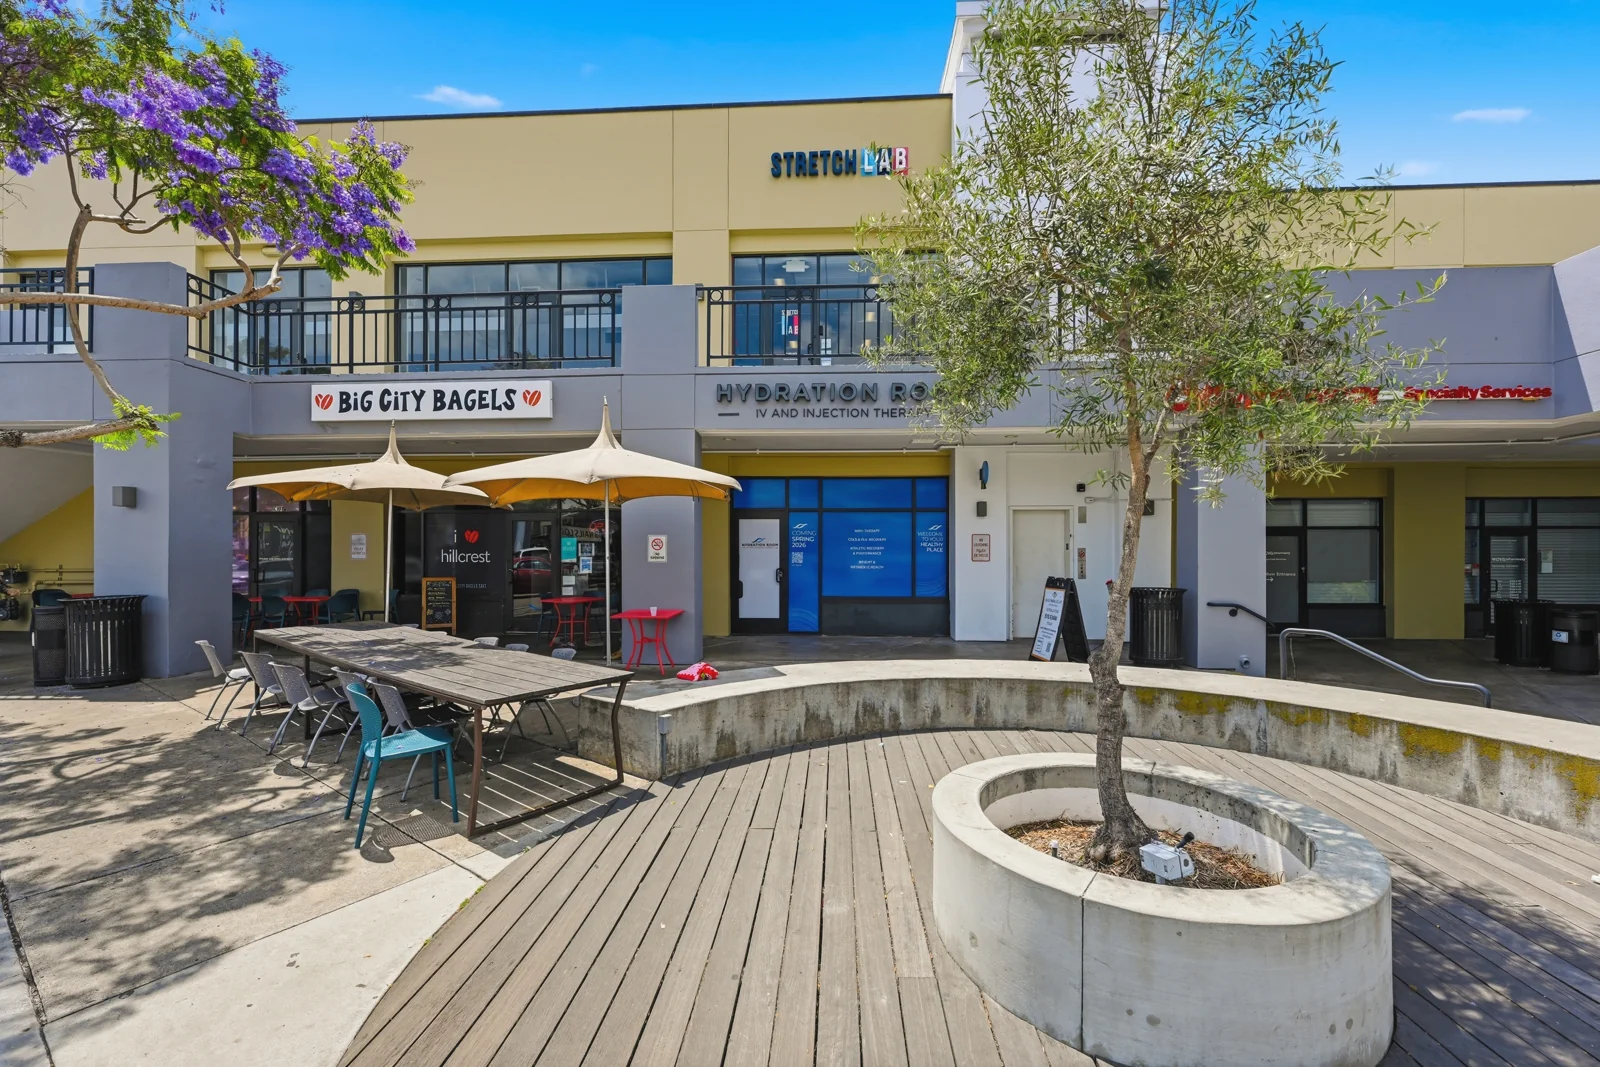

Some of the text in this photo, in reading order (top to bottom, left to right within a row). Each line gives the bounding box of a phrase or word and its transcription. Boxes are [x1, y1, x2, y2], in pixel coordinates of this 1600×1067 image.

[716, 382, 879, 403] HYDRATION
[1480, 384, 1553, 399] Services
[432, 388, 517, 412] BAGELS
[755, 408, 768, 418] IV
[771, 408, 799, 418] AND
[802, 407, 870, 418] INJECTION
[454, 529, 457, 543] i
[441, 548, 491, 563] hillcrest
